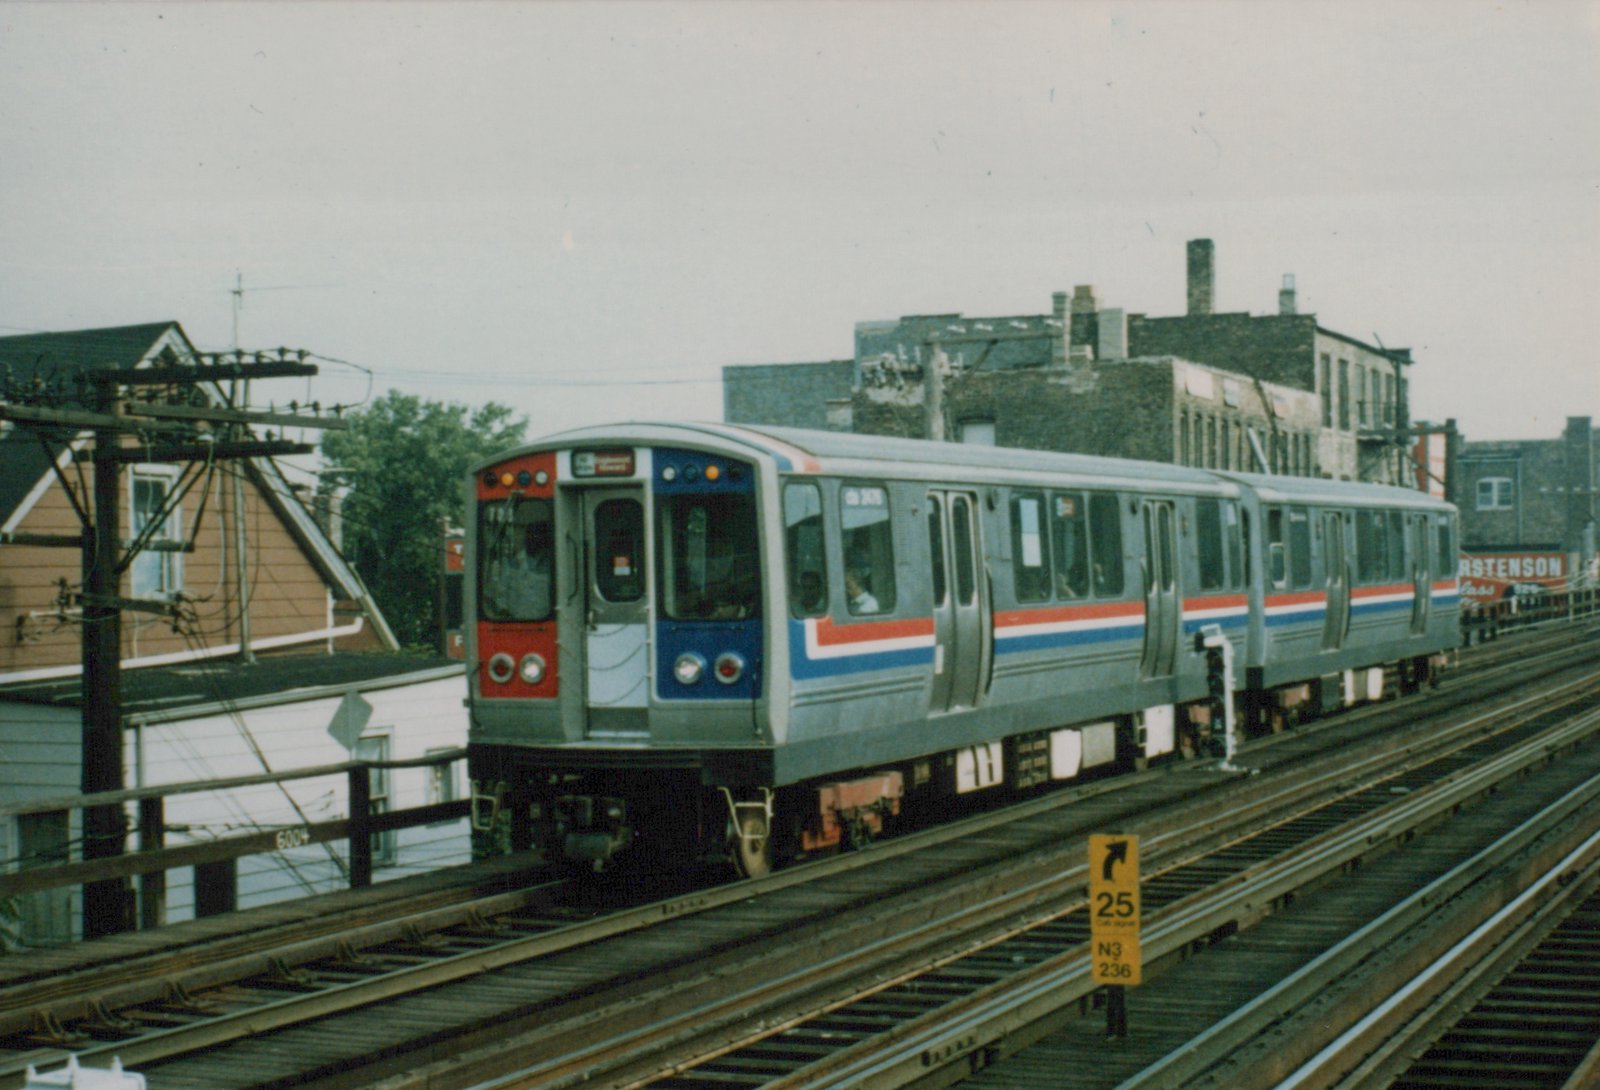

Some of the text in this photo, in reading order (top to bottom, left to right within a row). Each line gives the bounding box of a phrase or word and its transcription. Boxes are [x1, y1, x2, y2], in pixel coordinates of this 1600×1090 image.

[276, 829, 310, 850] 6004
[1096, 891, 1135, 918] 25
[1098, 941, 1122, 957] N3
[1099, 962, 1132, 978] 236
